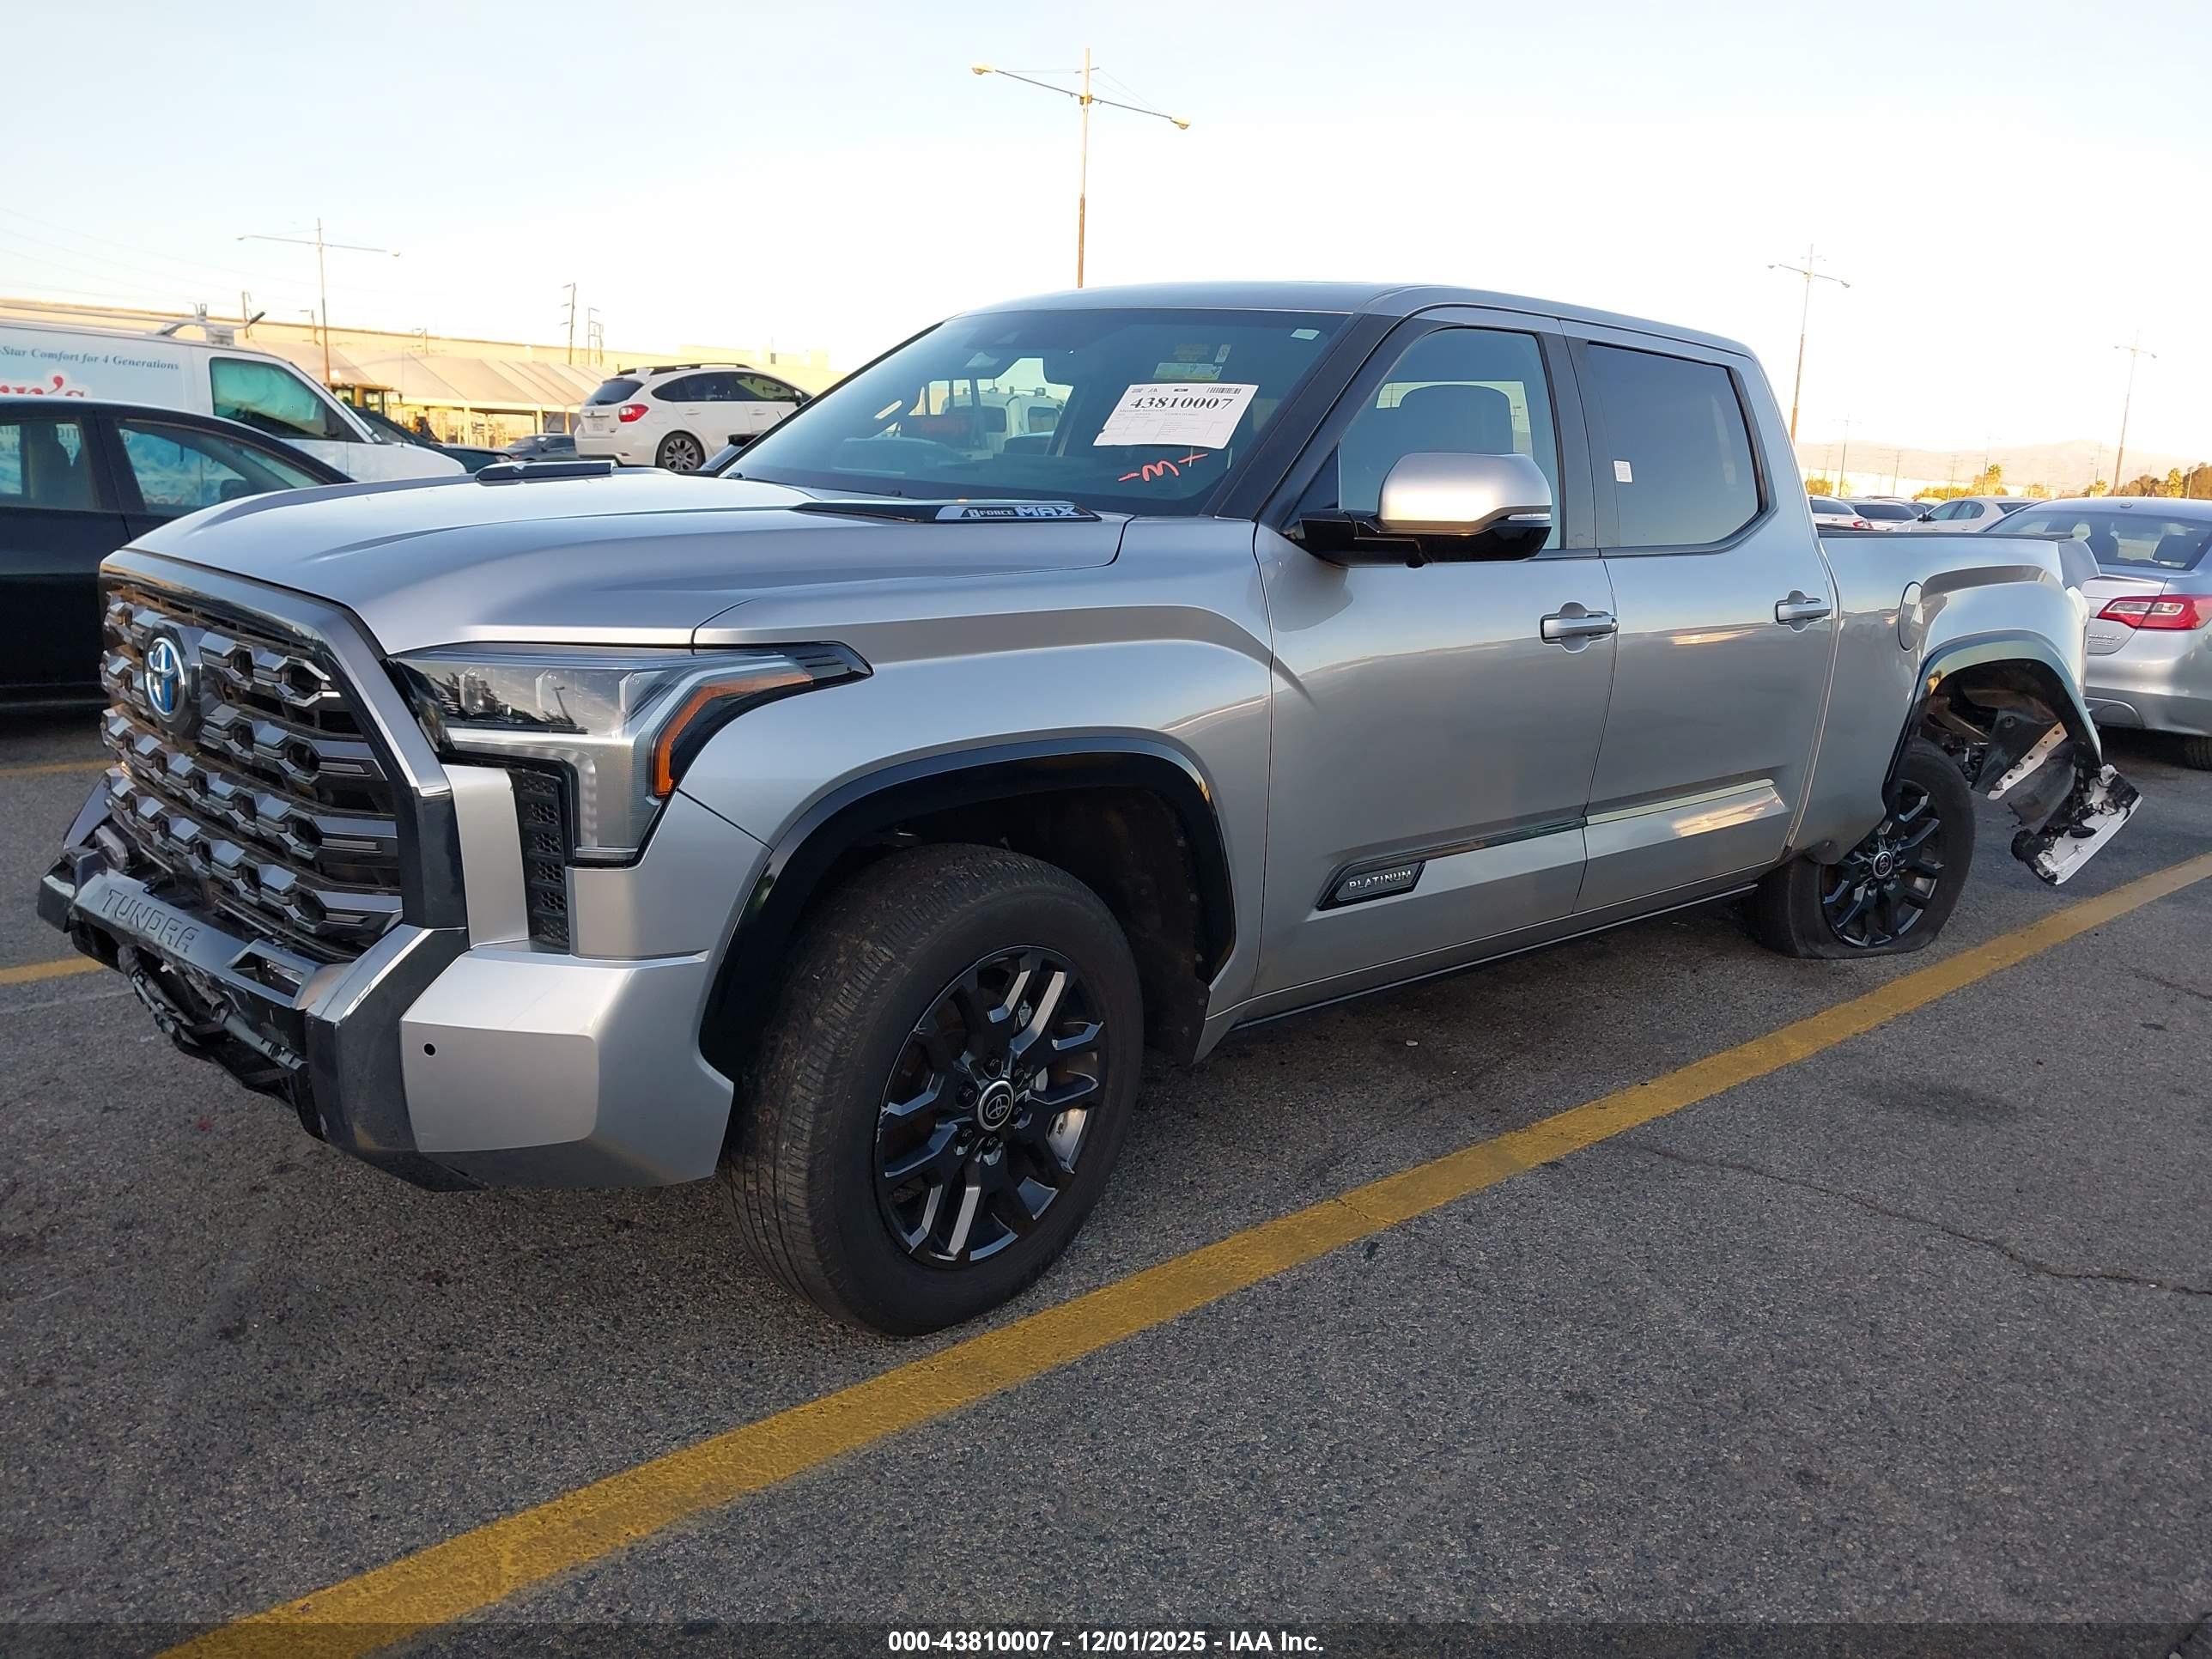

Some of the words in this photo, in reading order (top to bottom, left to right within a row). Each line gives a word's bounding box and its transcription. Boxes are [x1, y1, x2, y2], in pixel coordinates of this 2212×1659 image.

[31, 349, 79, 362] Comfort
[80, 353, 99, 364] for
[102, 355, 109, 364] 4
[112, 356, 179, 370] Generations
[1129, 397, 1234, 410] 43810007
[1014, 505, 1079, 516] MAX
[1348, 869, 1412, 891] PLATINUM
[101, 889, 200, 954] TUNDRA
